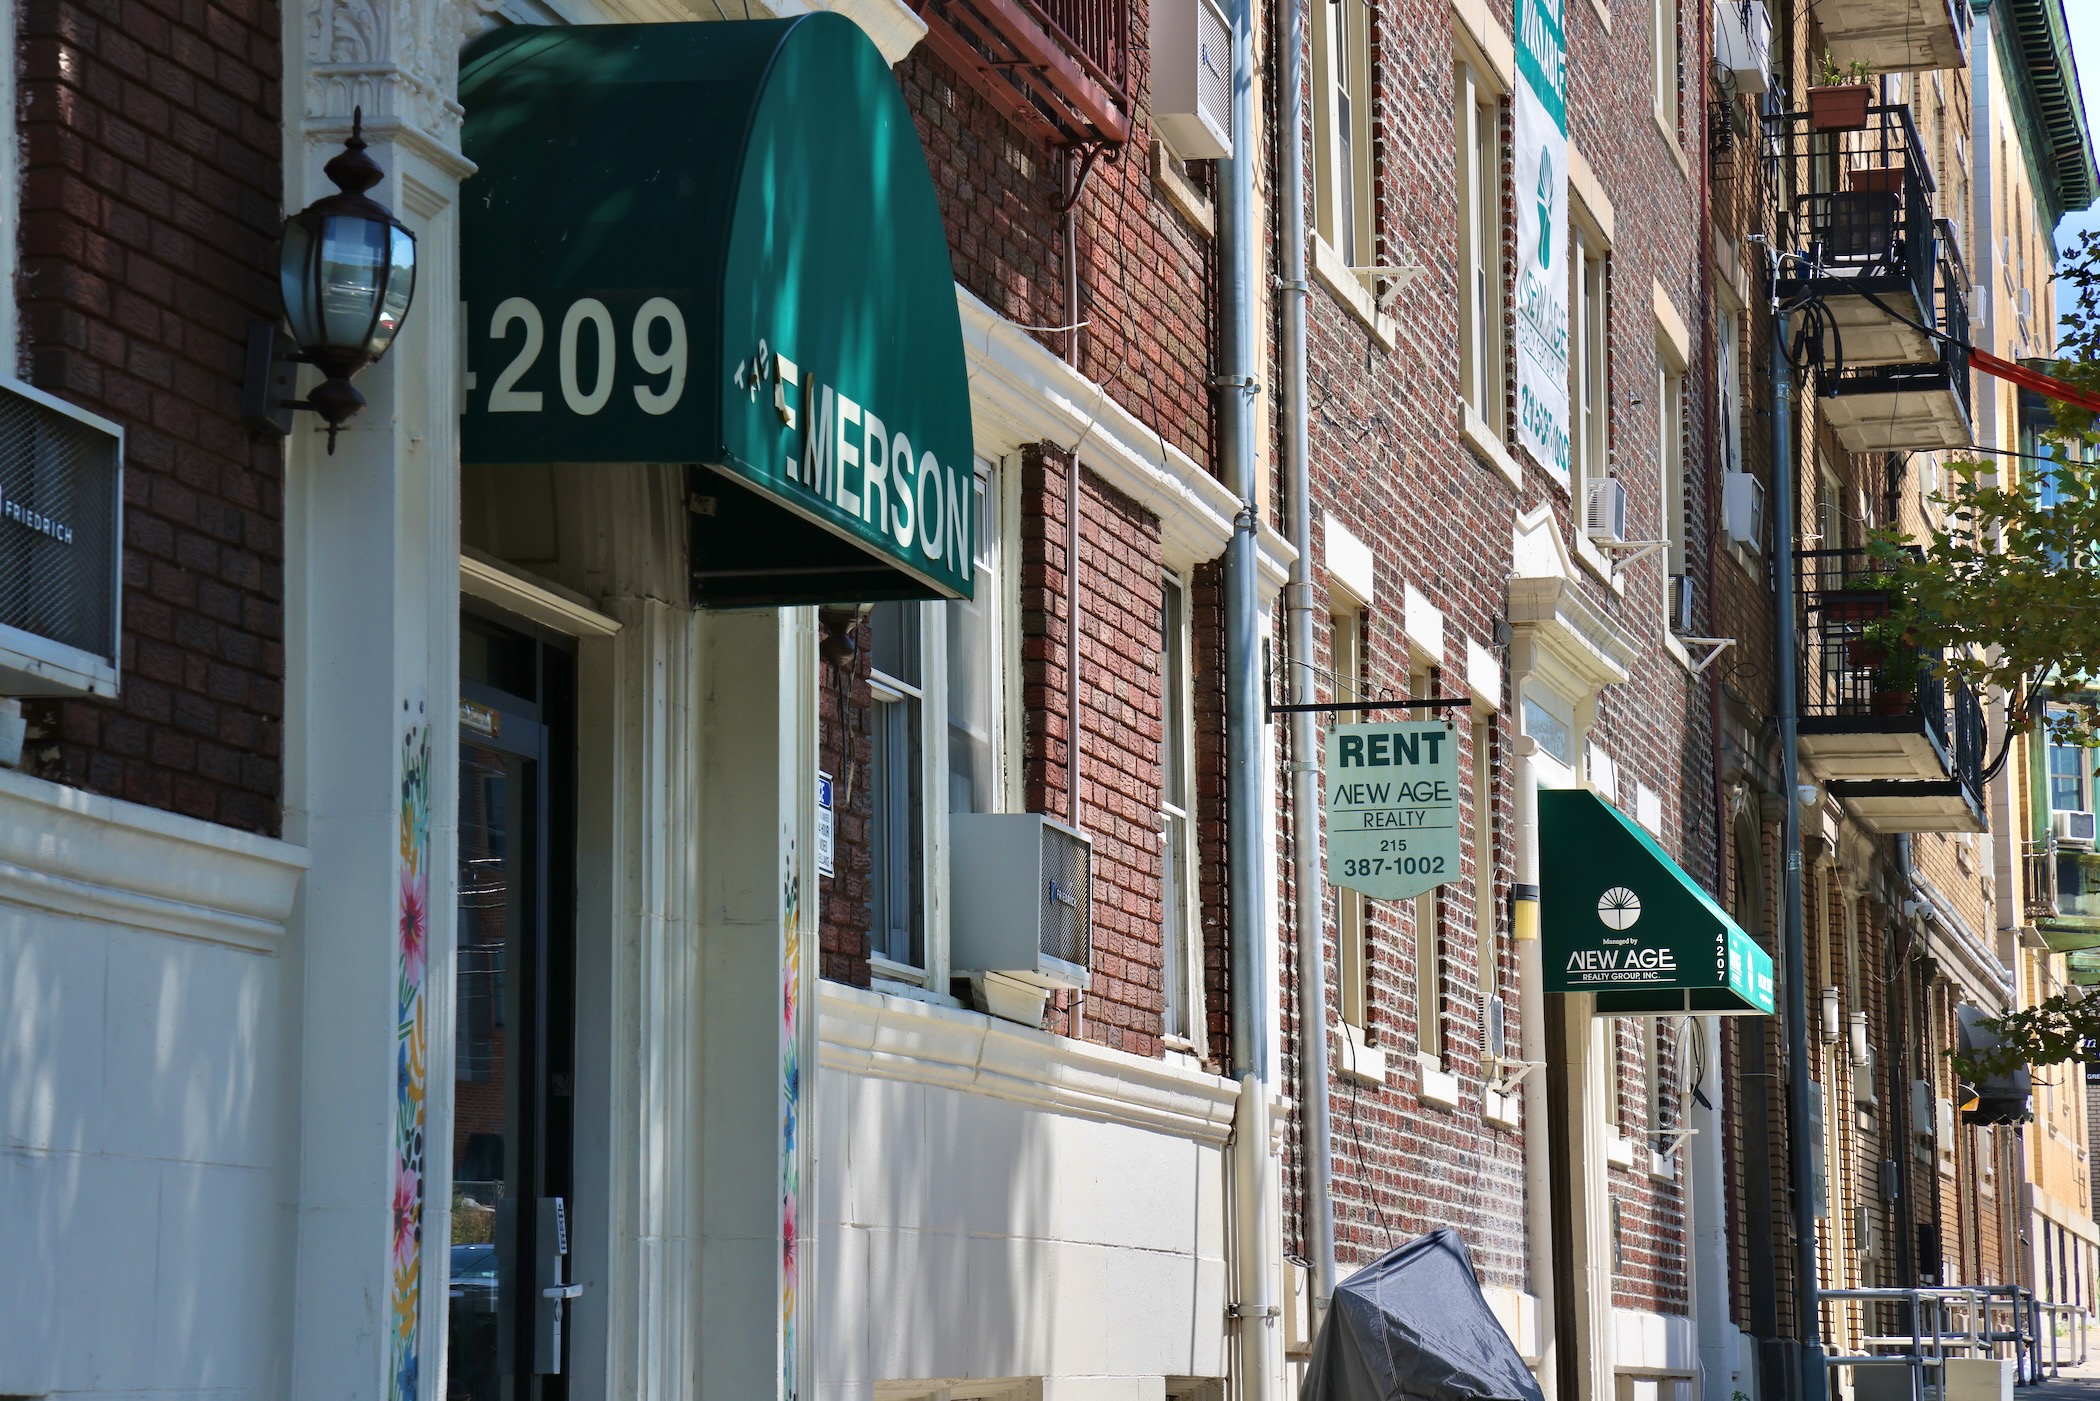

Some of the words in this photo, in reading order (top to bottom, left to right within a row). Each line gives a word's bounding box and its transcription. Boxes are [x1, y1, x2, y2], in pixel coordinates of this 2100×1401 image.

[1545, 292, 1567, 360] AGE
[774, 352, 969, 582] EMERSON
[5, 500, 73, 545] FRIEDRICH
[1339, 731, 1446, 768] RENT
[1333, 782, 1391, 805] NEW
[1397, 781, 1452, 803] AGE
[1363, 811, 1426, 828] REALTY
[1380, 839, 1407, 852] 215
[1344, 856, 1445, 877] 387-1002
[1603, 938, 1629, 946] Managed
[1630, 937, 1638, 945] by
[1566, 950, 1619, 971] NEW
[1623, 948, 1677, 969] AGE
[1716, 933, 1725, 981] 4207
[1583, 972, 1610, 981] REALTY
[1643, 971, 1661, 979] INC.
